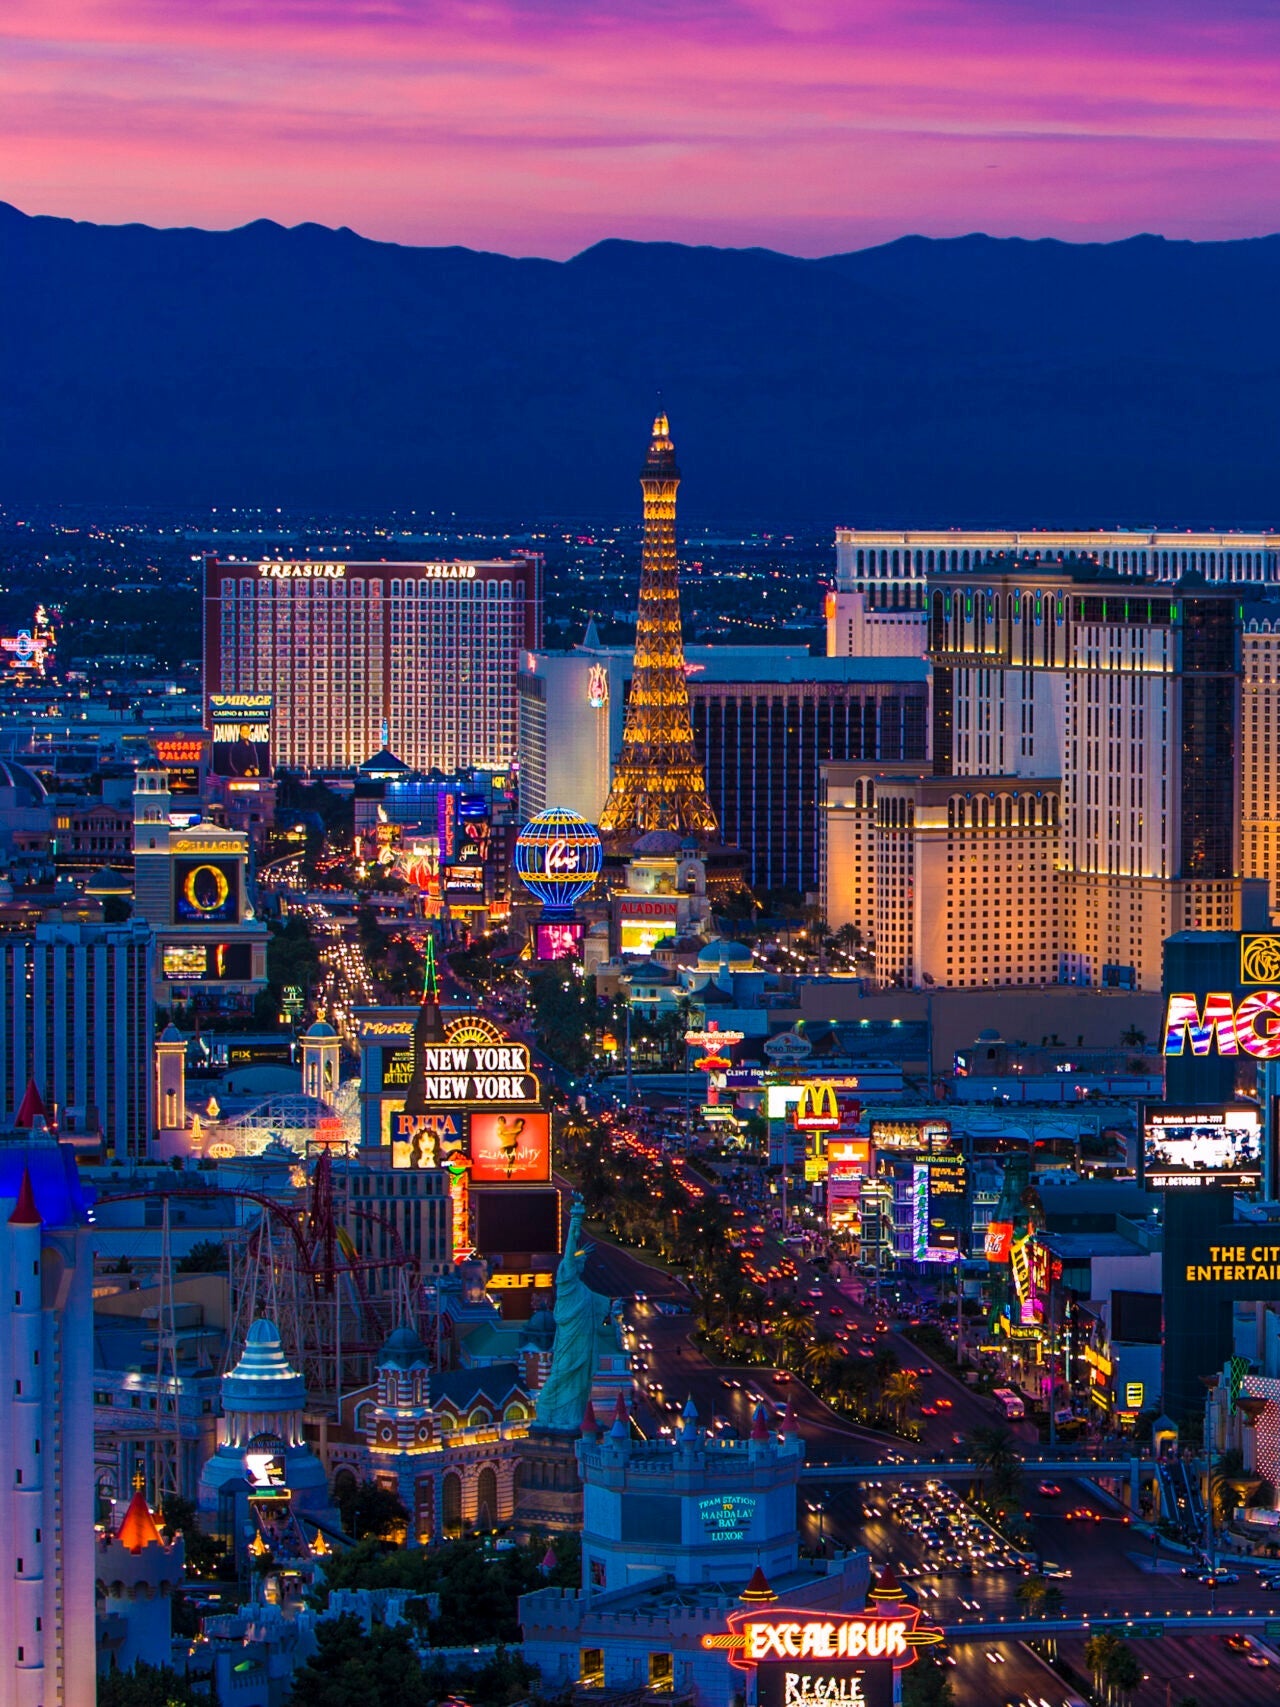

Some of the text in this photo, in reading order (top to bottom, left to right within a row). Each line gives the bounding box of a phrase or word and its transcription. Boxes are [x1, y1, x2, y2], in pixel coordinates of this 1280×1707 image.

[258, 565, 476, 578] TREASURE ISLAND
[224, 695, 272, 706] MIRAGE
[213, 724, 270, 742] DANNY GANS
[156, 741, 203, 751] CAESARS
[158, 751, 201, 760] PALACE
[176, 839, 242, 852] BELLAGIO
[184, 864, 229, 911] O
[620, 902, 677, 915] ALADDIN
[232, 1050, 251, 1059] FIX
[425, 1048, 469, 1071] NEW
[473, 1048, 525, 1070] YORK
[425, 1077, 525, 1099] NEW YORK
[397, 1114, 457, 1134] RITA
[478, 1146, 541, 1161] ZUMANITY
[1210, 1247, 1245, 1262] THE
[699, 1496, 756, 1510] TRAM STATION
[701, 1509, 753, 1520] MANDALAY
[718, 1519, 736, 1528] BAY
[712, 1532, 743, 1541] LUXOR
[751, 1621, 908, 1658] EXCALIBUR
[785, 1672, 864, 1705] REGALE
